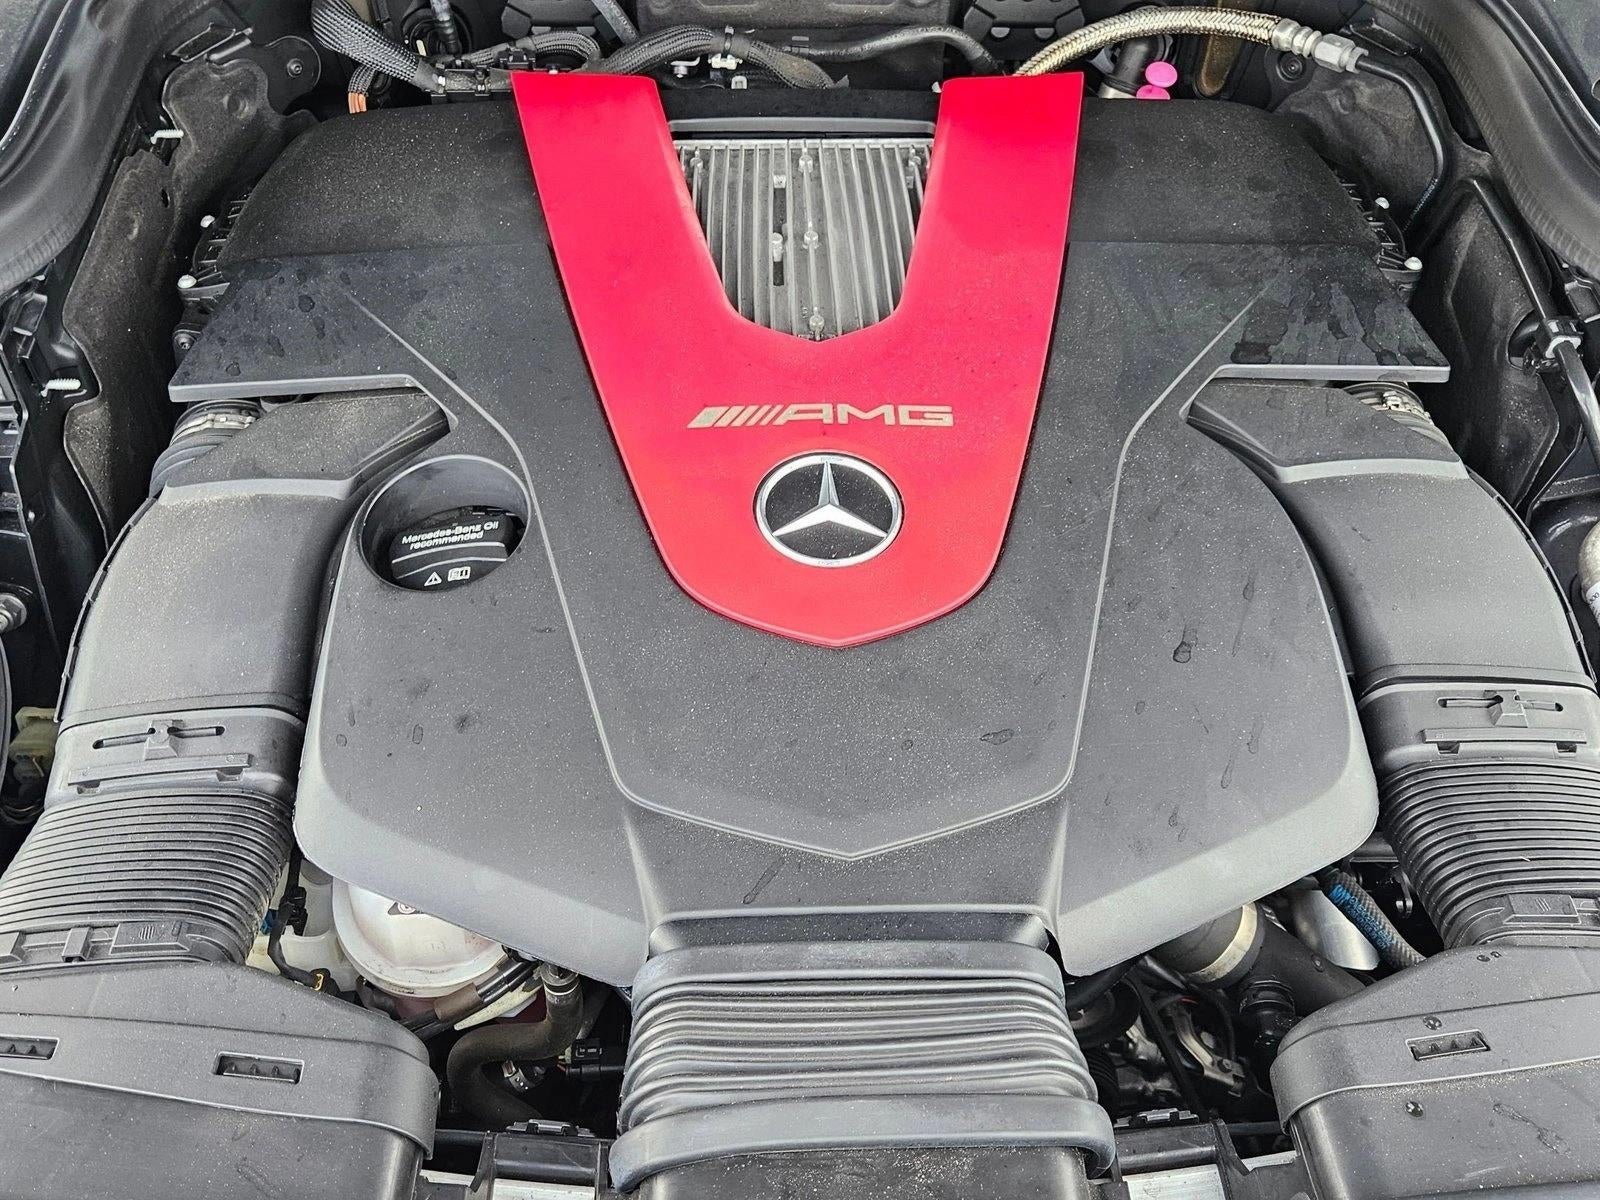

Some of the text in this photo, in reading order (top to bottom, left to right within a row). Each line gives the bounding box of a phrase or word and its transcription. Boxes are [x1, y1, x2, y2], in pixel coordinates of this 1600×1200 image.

[773, 403, 954, 426] AMG
[401, 520, 499, 544] Mercedes-Benz Oil
[410, 530, 484, 550] recommended
